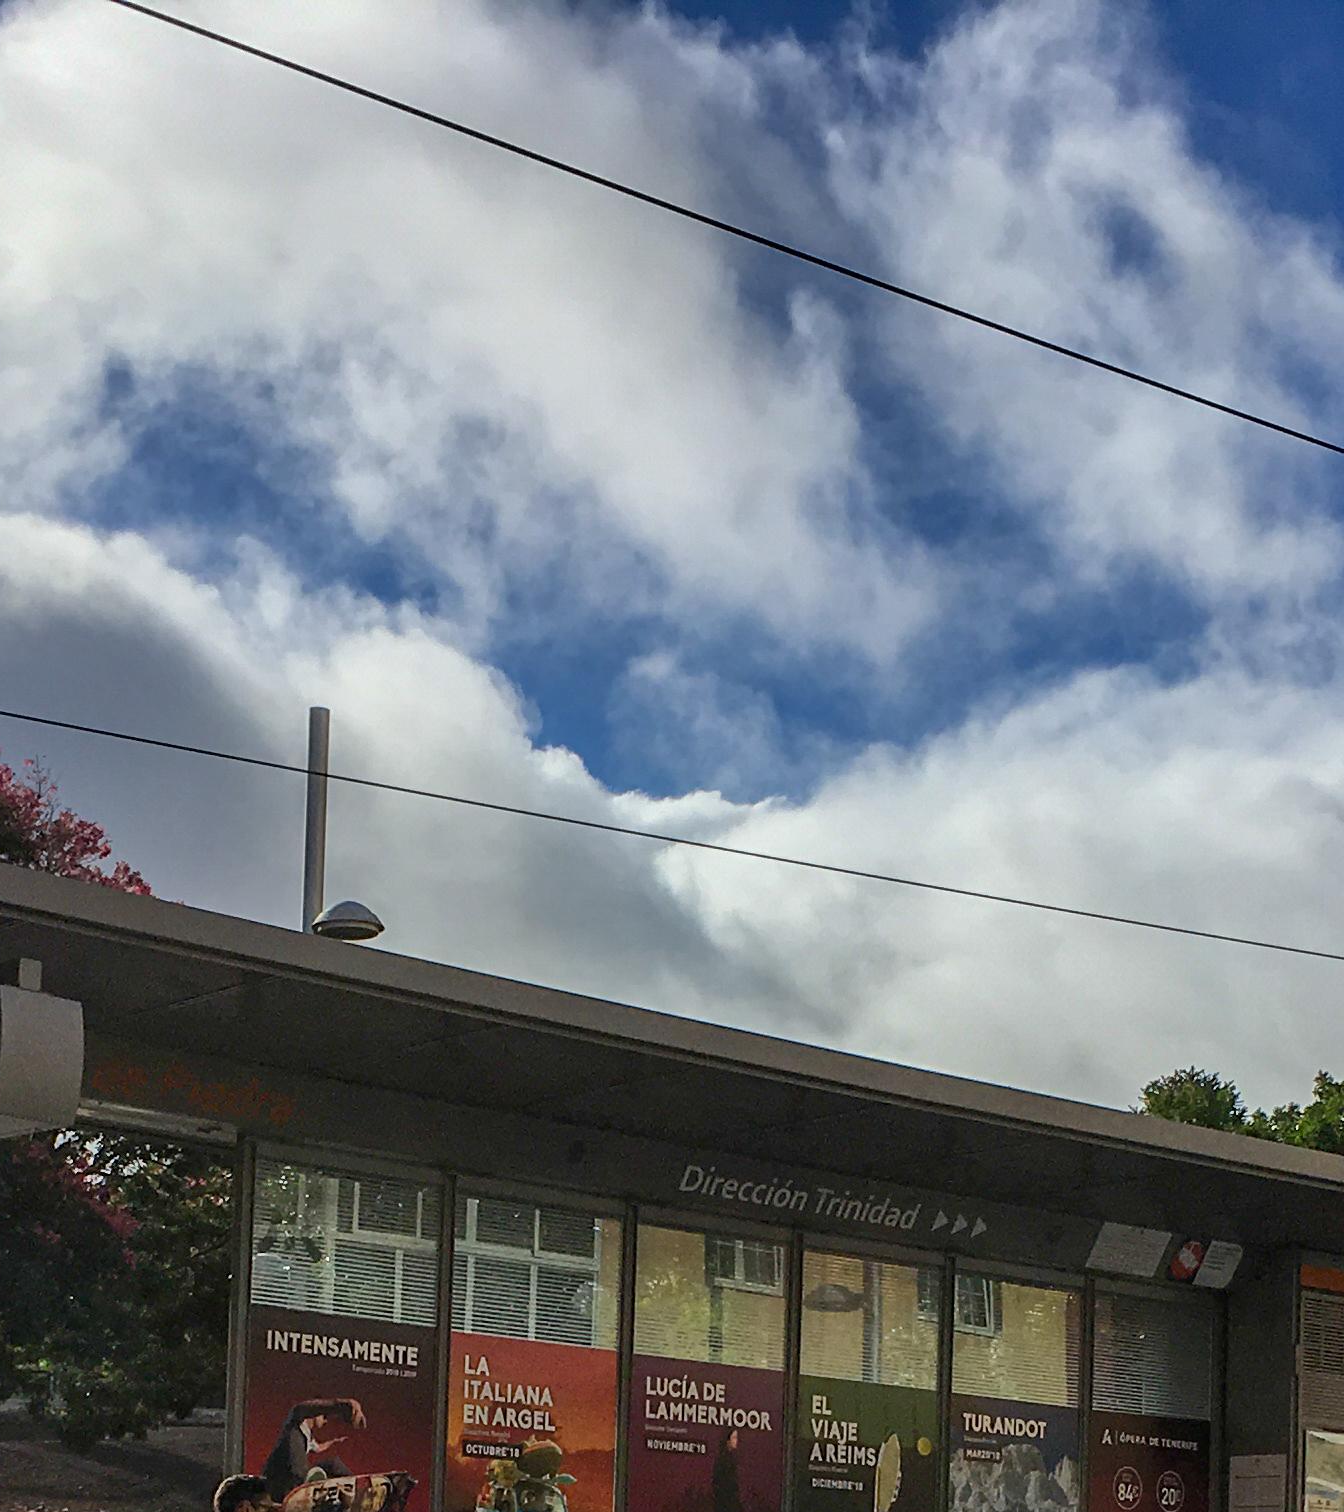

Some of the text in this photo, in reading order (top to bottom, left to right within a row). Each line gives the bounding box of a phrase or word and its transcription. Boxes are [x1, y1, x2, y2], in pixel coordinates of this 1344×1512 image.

[679, 1165, 922, 1230] Dirección Trinidad
[267, 1330, 419, 1366] INTENSAMENTE
[464, 1354, 490, 1377] LA
[463, 1380, 554, 1408] ITALIANA
[646, 1374, 726, 1403] LUCÍA DE
[463, 1404, 556, 1432] EN ARGEL
[645, 1399, 773, 1431] LAMMERMOOR
[812, 1395, 832, 1415] EL
[811, 1418, 858, 1445] VIAJE
[962, 1412, 1047, 1439] TURANDOT
